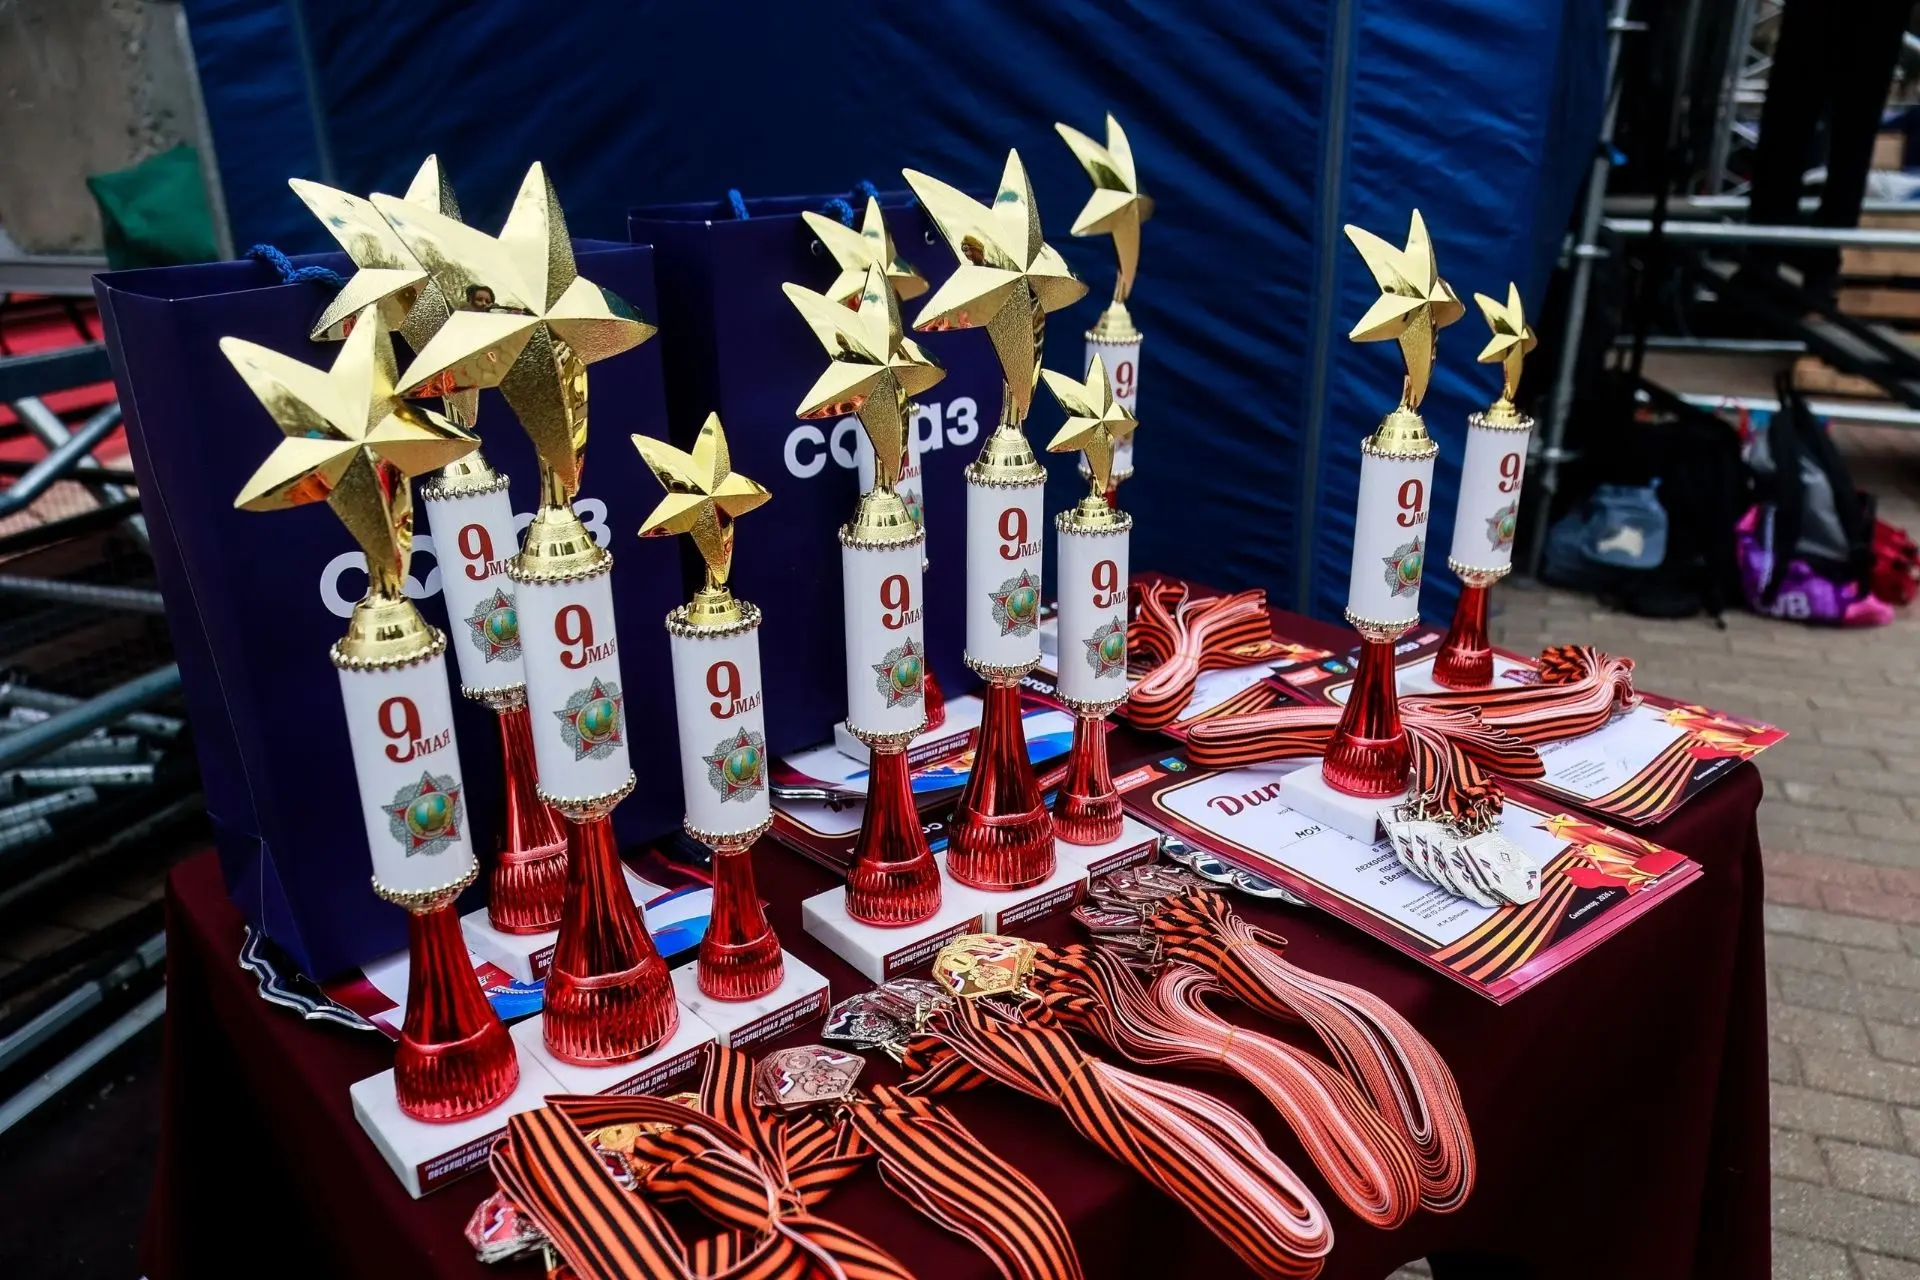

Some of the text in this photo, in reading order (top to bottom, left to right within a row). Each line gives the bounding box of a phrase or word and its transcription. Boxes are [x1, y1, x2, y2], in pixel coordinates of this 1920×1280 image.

[1116, 361, 1133, 398] 9
[784, 397, 979, 478] соаз
[1499, 453, 1520, 492] 9
[1397, 479, 1423, 527] 9
[458, 524, 494, 580] 9
[999, 508, 1027, 560] 9
[881, 575, 909, 629] 9
[1092, 560, 1117, 608] 9
[555, 605, 616, 669] 9 МАЯ
[707, 661, 760, 719] 9 МАЯ
[378, 697, 451, 763] 9 МАЯ
[1207, 783, 1280, 816] Дип
[733, 1022, 778, 1049] ПОСВЯЩЕННАЯ
[795, 1000, 820, 1020] ПОБЕДЫ
[669, 1058, 697, 1077] ПОБЕДЫ
